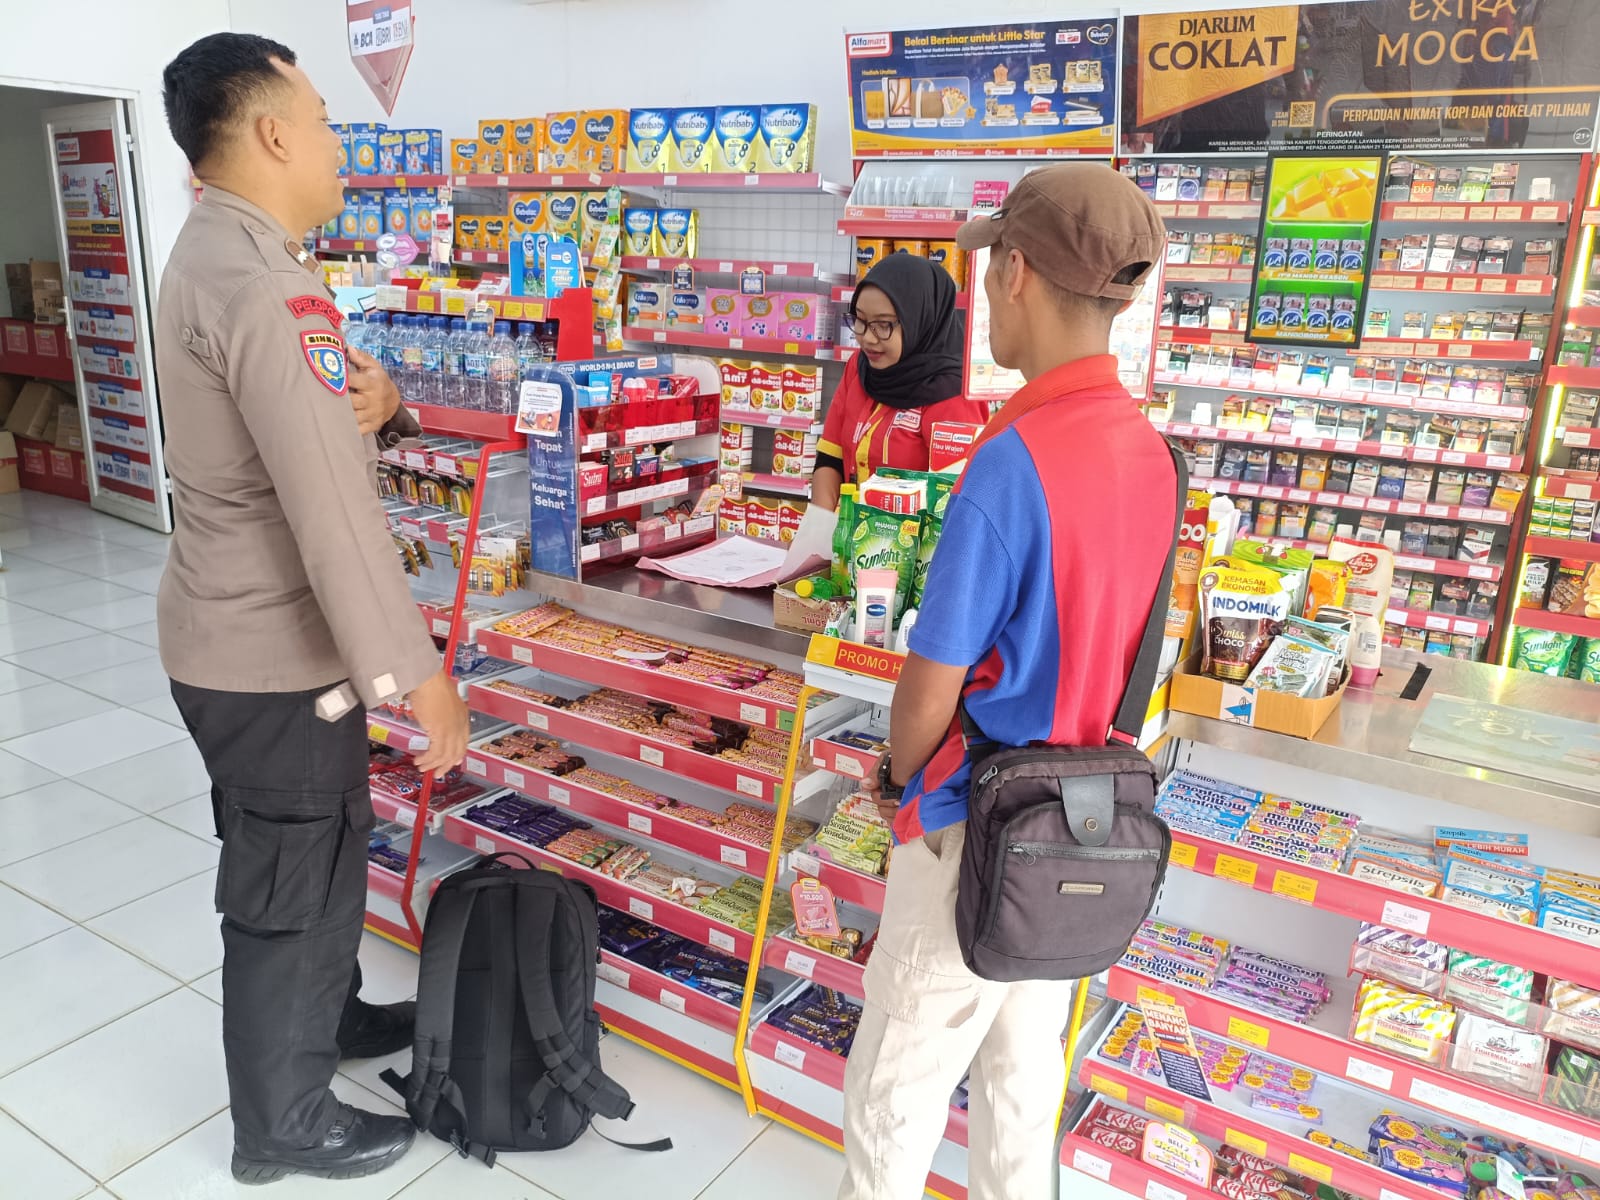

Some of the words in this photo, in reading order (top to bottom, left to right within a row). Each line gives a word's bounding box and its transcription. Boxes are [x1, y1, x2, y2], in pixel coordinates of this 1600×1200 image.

[1179, 16, 1255, 37] DJARUM
[360, 32, 373, 47] BCA
[851, 36, 887, 48] Alfamart
[904, 36, 929, 48] Bekal
[930, 34, 968, 46] Bersinar
[971, 33, 996, 44] untuk
[998, 32, 1022, 42] Little
[1024, 30, 1046, 41] Star
[1376, 26, 1539, 67] MOCCA
[1150, 36, 1287, 71] COKLAT
[1343, 108, 1400, 122] PERPADUAN
[1403, 106, 1442, 121] NIKMAT
[1444, 106, 1469, 120] KOPI
[1472, 105, 1493, 119] DAN
[1496, 104, 1544, 118] COKELAT
[1546, 103, 1591, 117] PILIHAN
[586, 124, 611, 133] Bebelac
[634, 120, 665, 130] Nutribaby
[719, 119, 754, 130] Nutribaby
[764, 118, 802, 129] Nutribaby
[1316, 130, 1363, 138] PERINGATAN
[516, 208, 537, 216] Bebelac
[294, 300, 341, 326] PELOPOR
[698, 314, 704, 324] 3
[616, 361, 635, 370] BRAND
[535, 439, 562, 454] Tepat
[945, 444, 964, 453] Wajah
[536, 454, 562, 469] Untuk
[584, 472, 603, 487] Sutra
[532, 482, 567, 497] Keluarga
[1382, 483, 1400, 493] evo
[535, 496, 566, 511] Sehat
[857, 548, 900, 570] Sunlight
[1222, 582, 1267, 594] EKONOMIS
[1224, 576, 1266, 587] KEMASAN
[1213, 596, 1281, 617] INDOMILK
[1215, 638, 1244, 648] CHOCO
[1522, 640, 1562, 655] Sunlight
[838, 648, 889, 672] PROMO
[1183, 770, 1217, 785] mentos
[1178, 782, 1228, 801] mentos
[1170, 793, 1223, 811] mentos
[830, 819, 861, 836] SILVERQUEEN
[1267, 812, 1322, 830] mentos
[823, 828, 855, 843] SILVERQUEEN
[1251, 834, 1307, 853] mentos
[1467, 844, 1492, 852] LEBIH
[1494, 846, 1525, 855] MURAH
[1361, 864, 1425, 889] Strepsils
[712, 895, 748, 913] SILVERQUEEN
[1452, 887, 1520, 911] Strepsils
[698, 904, 734, 924] SILVERQUEEN
[1126, 954, 1178, 976] mentos
[1245, 963, 1299, 986] mentos
[1145, 1008, 1187, 1027] MENANG
[1092, 1130, 1135, 1149] KitKat
[1242, 1170, 1281, 1191] KitKat
